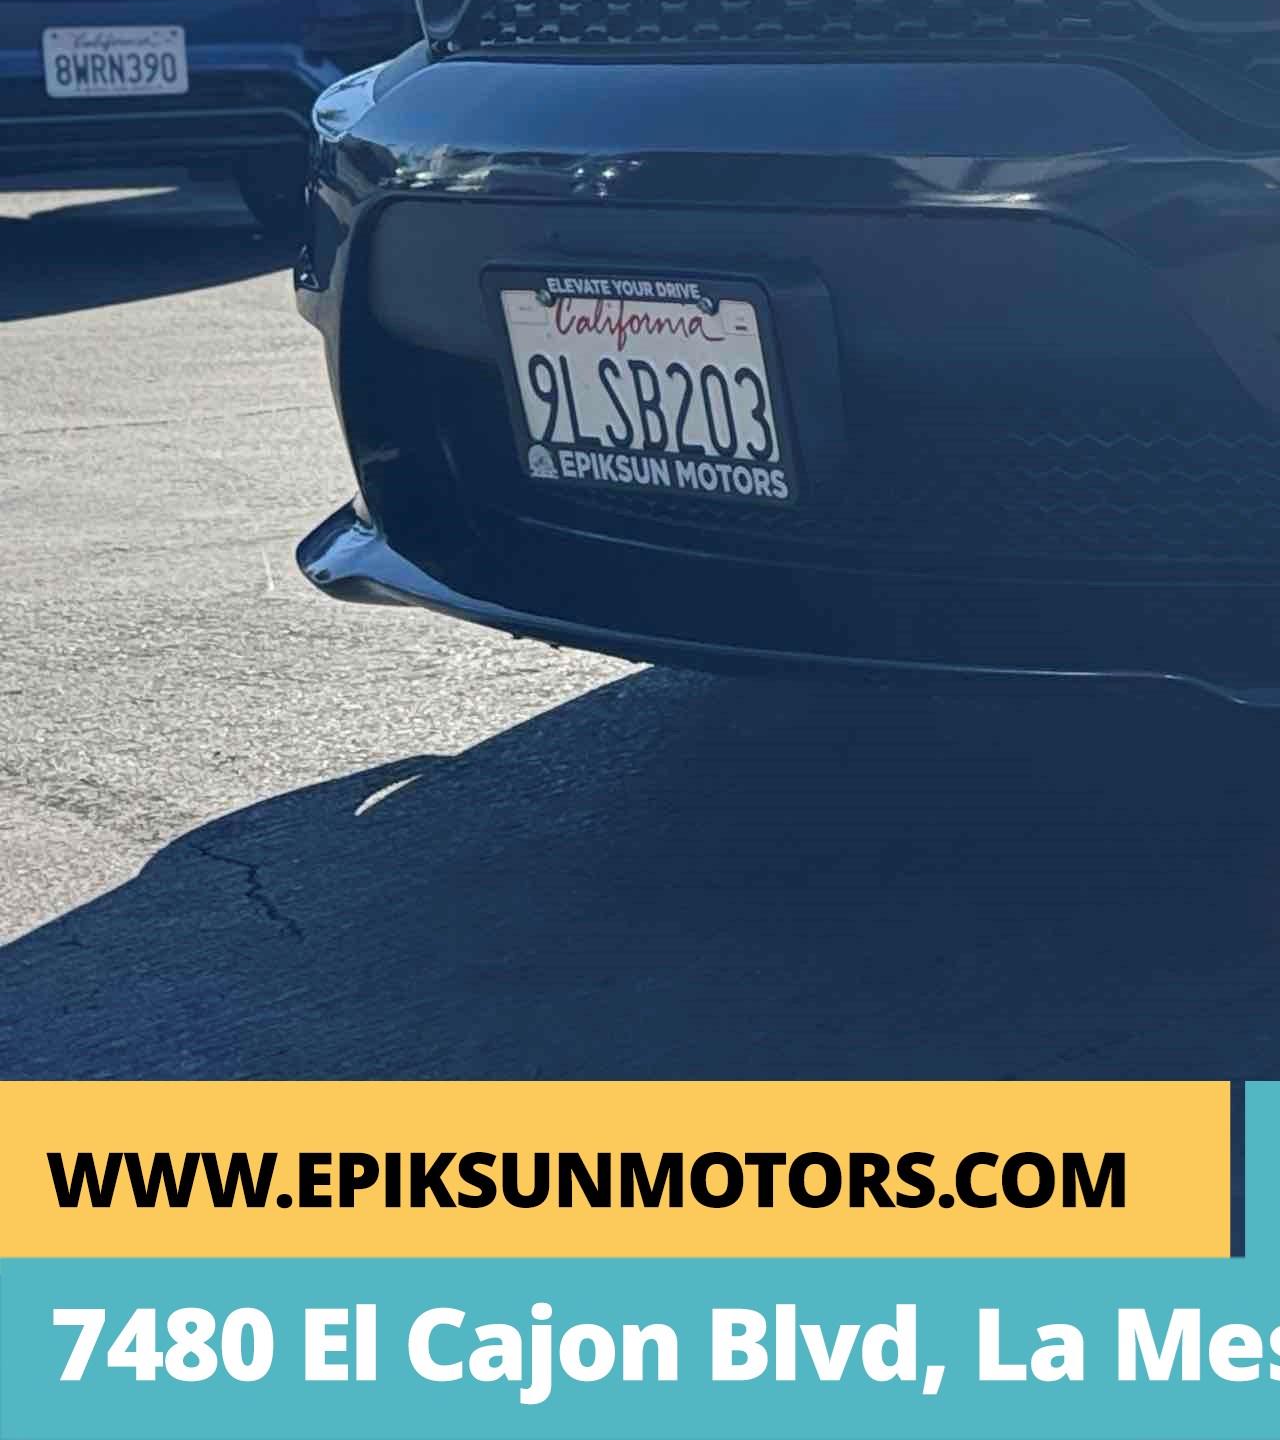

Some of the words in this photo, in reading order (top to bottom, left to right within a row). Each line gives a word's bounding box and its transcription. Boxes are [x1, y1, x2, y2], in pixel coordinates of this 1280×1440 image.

[55, 52, 177, 86] 8WRN390
[546, 277, 611, 296] ELEVATE
[613, 279, 653, 297] YOUR
[656, 282, 700, 299] DRIVE
[555, 297, 725, 352] California
[528, 353, 774, 462] 9LSB203
[557, 449, 671, 488] EPIKSUN
[676, 459, 789, 500] MOTORS
